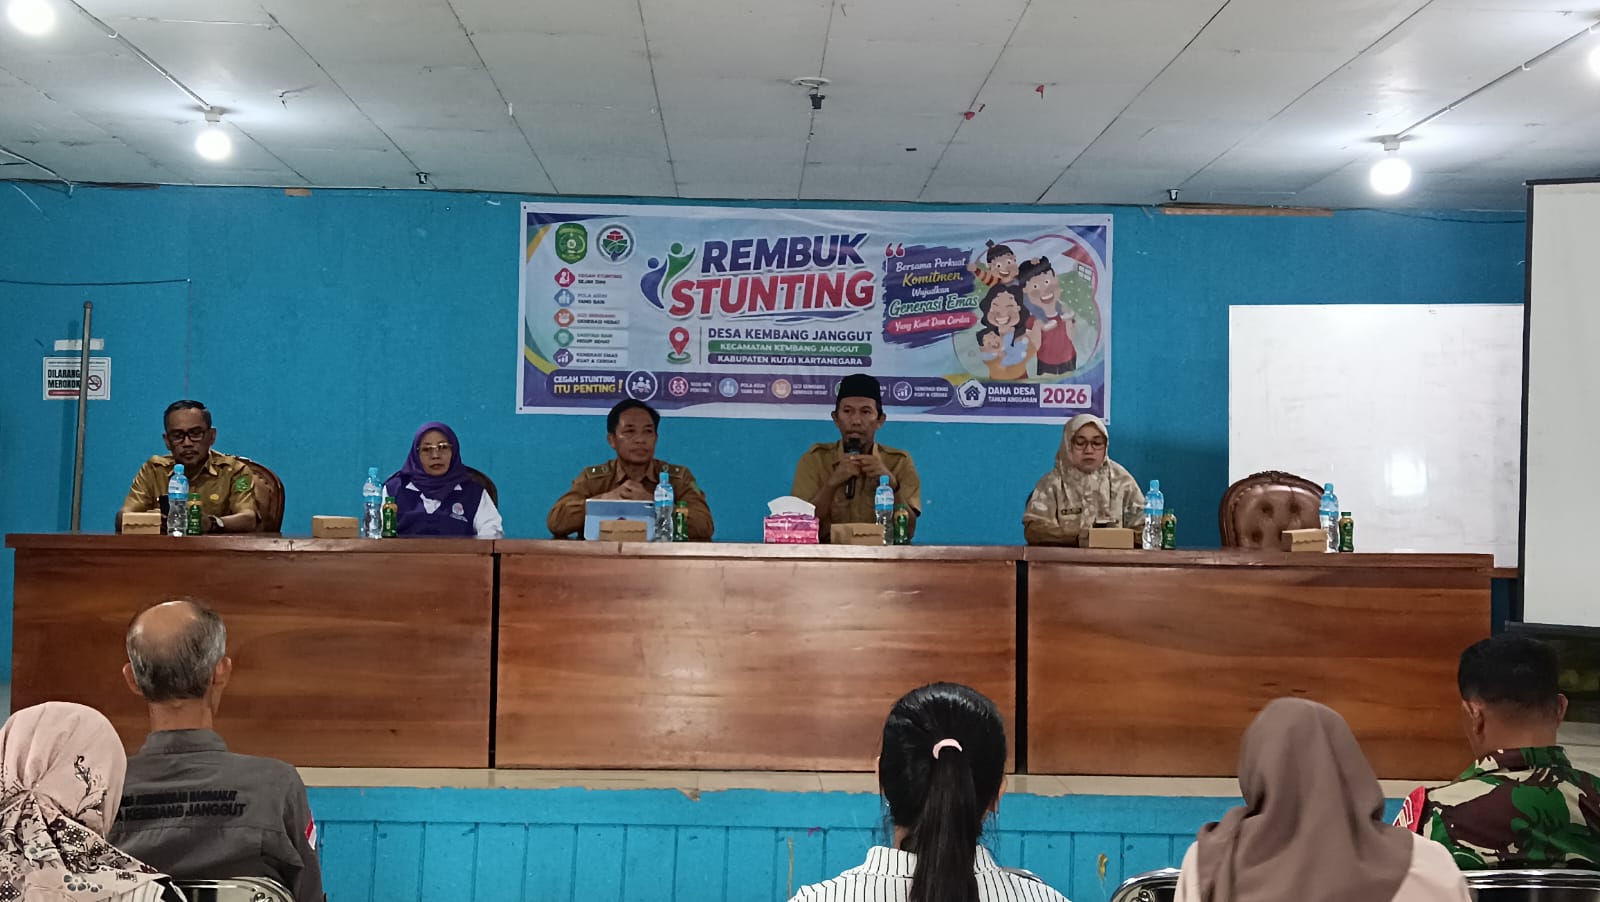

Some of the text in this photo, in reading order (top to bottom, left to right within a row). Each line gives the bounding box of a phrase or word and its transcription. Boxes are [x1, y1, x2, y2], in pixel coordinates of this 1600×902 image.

[701, 232, 868, 273] REMBUK
[896, 257, 967, 272] Bersama Perkuat
[668, 271, 875, 316] STUNTING
[911, 285, 950, 298] Wujudkan
[889, 293, 979, 316] Generasi Emas
[895, 315, 970, 332] Yang Kuat Dan Cerdas
[708, 328, 873, 342] DESA KEMBANG JANGGUT
[720, 343, 860, 353] KECAMATAN KEMBANG JANGGUT
[717, 355, 863, 366] KABUPATEN KUTAI KARTANEGARA
[47, 369, 80, 378] DILARANG
[553, 375, 616, 383] CEGAH STUNTING
[553, 384, 571, 393] ITU
[573, 383, 616, 393] PENTING
[988, 386, 1036, 396] DANA DESA
[1008, 396, 1038, 404] ANGGARAN
[1042, 387, 1088, 405] 2026
[185, 803, 248, 817] JANGGUT
